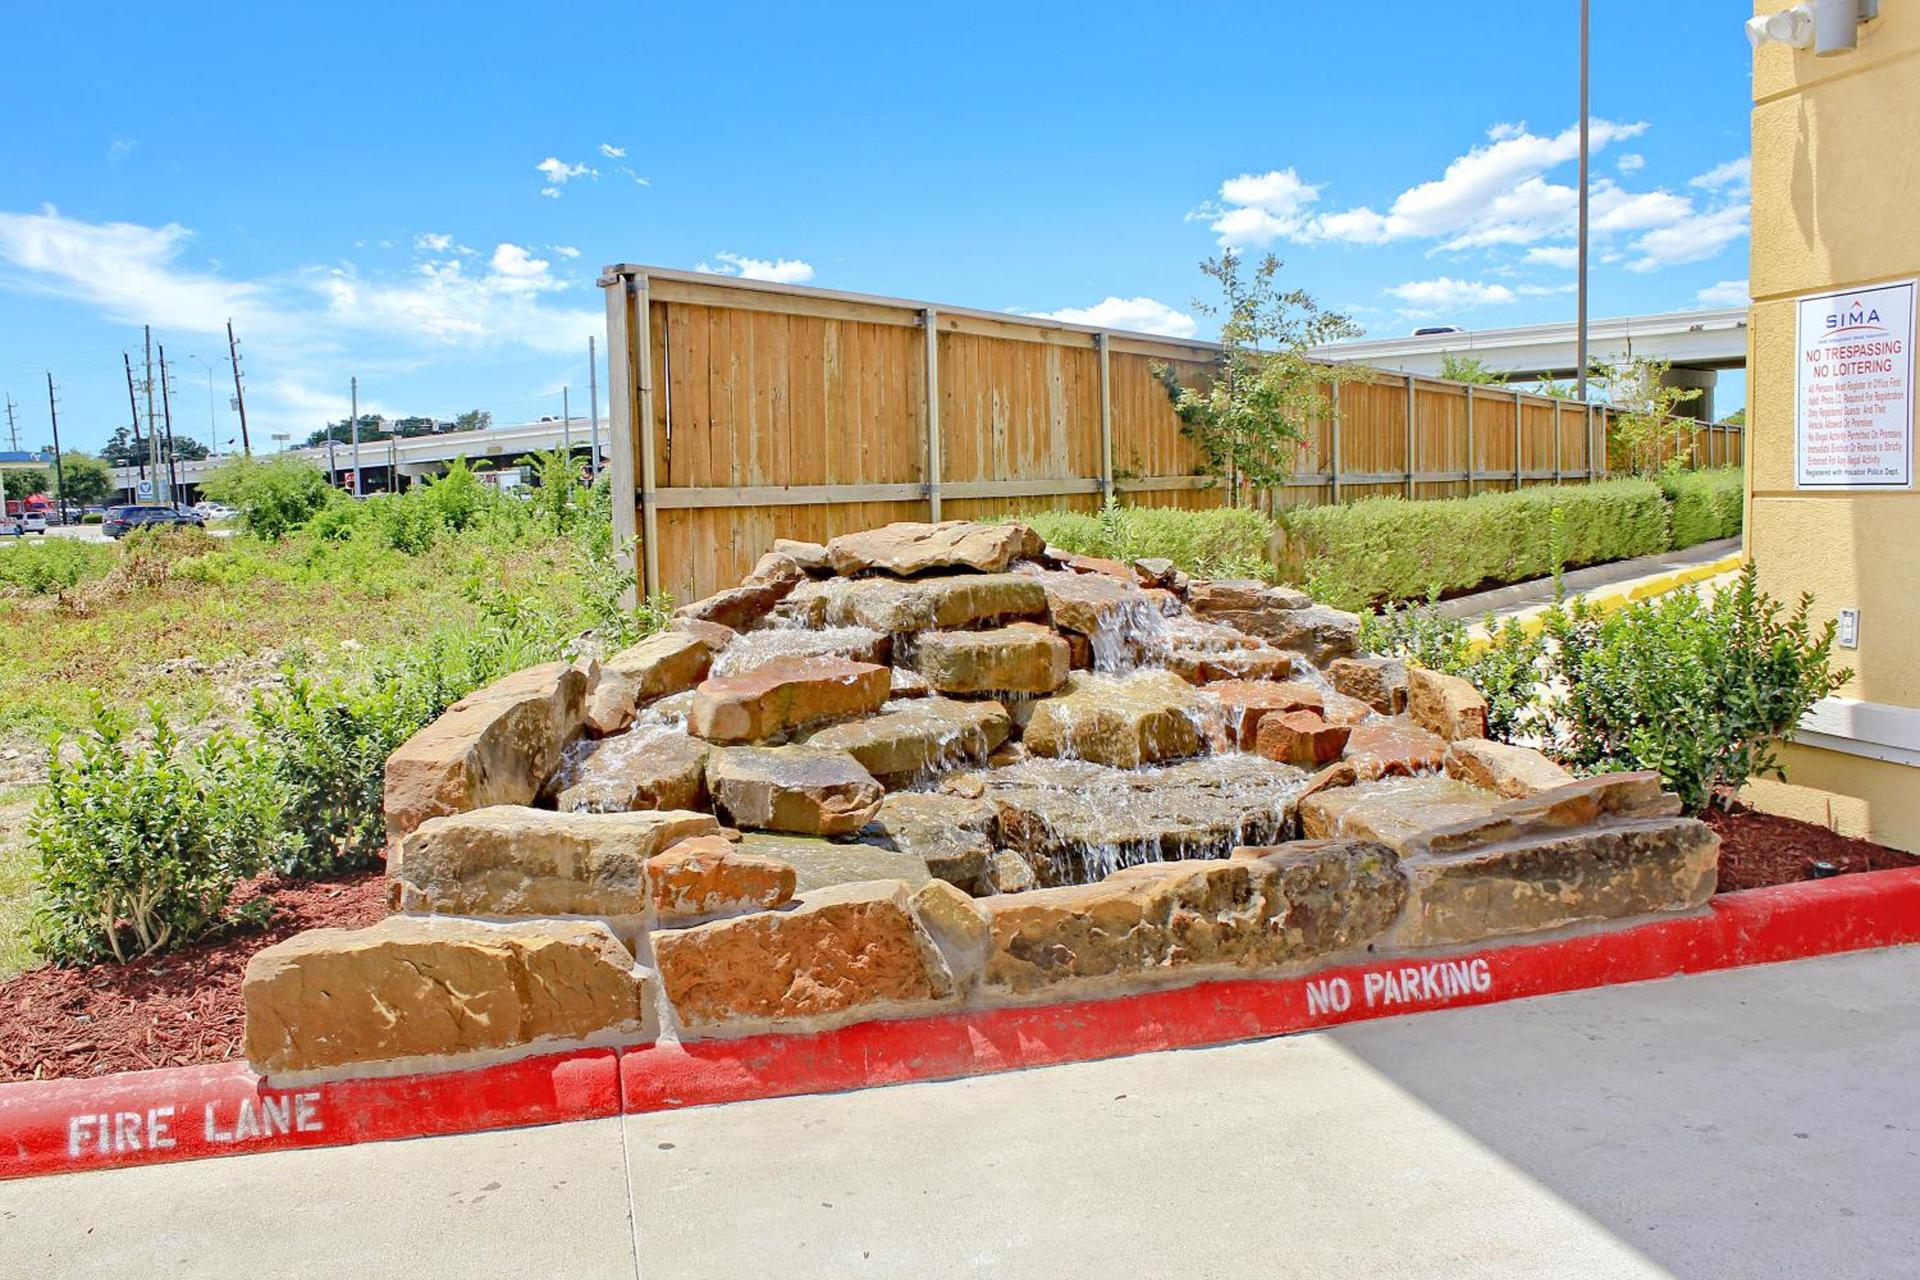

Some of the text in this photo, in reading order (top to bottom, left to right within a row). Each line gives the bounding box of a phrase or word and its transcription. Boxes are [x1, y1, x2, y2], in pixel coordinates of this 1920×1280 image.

[1826, 308, 1880, 328] SIMA
[1806, 340, 1902, 362] NO TRESPASSING
[1813, 359, 1892, 378] NO LOITERING
[1306, 959, 1492, 1016] NO PARKING
[68, 1092, 323, 1158] FIRE LANE
